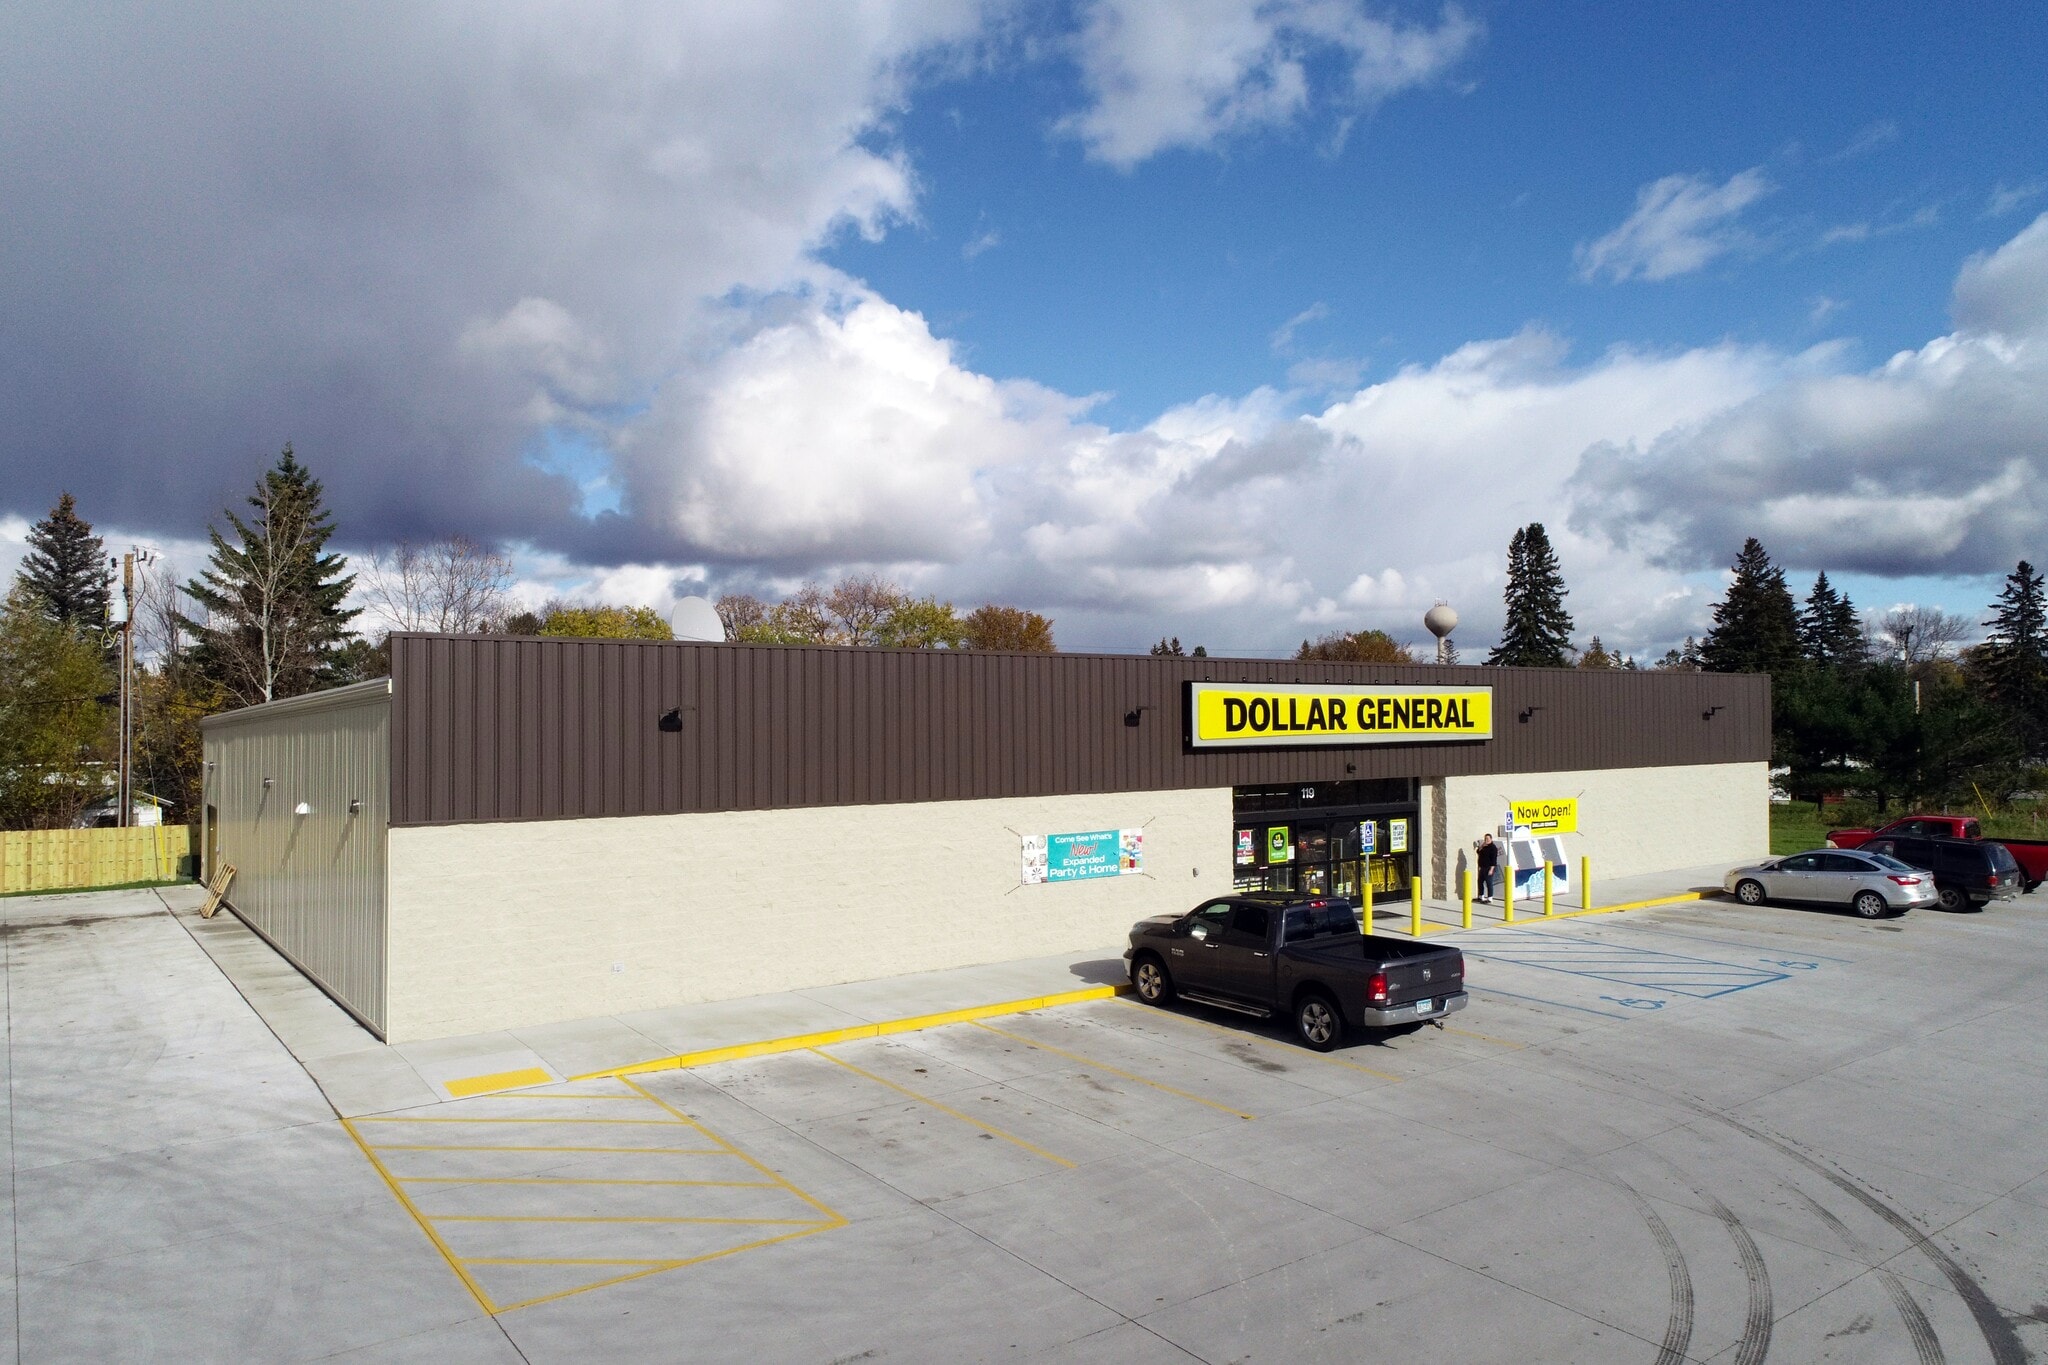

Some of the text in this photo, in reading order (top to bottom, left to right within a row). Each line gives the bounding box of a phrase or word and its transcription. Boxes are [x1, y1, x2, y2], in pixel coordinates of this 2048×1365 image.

[1223, 697, 1475, 732] DOLLAR GENERAL
[1301, 787, 1315, 799] 119
[1518, 804, 1571, 819] Now Open!
[1070, 842, 1098, 857] New!
[1063, 855, 1105, 867] Expanded
[1050, 864, 1118, 878] Party & Home
